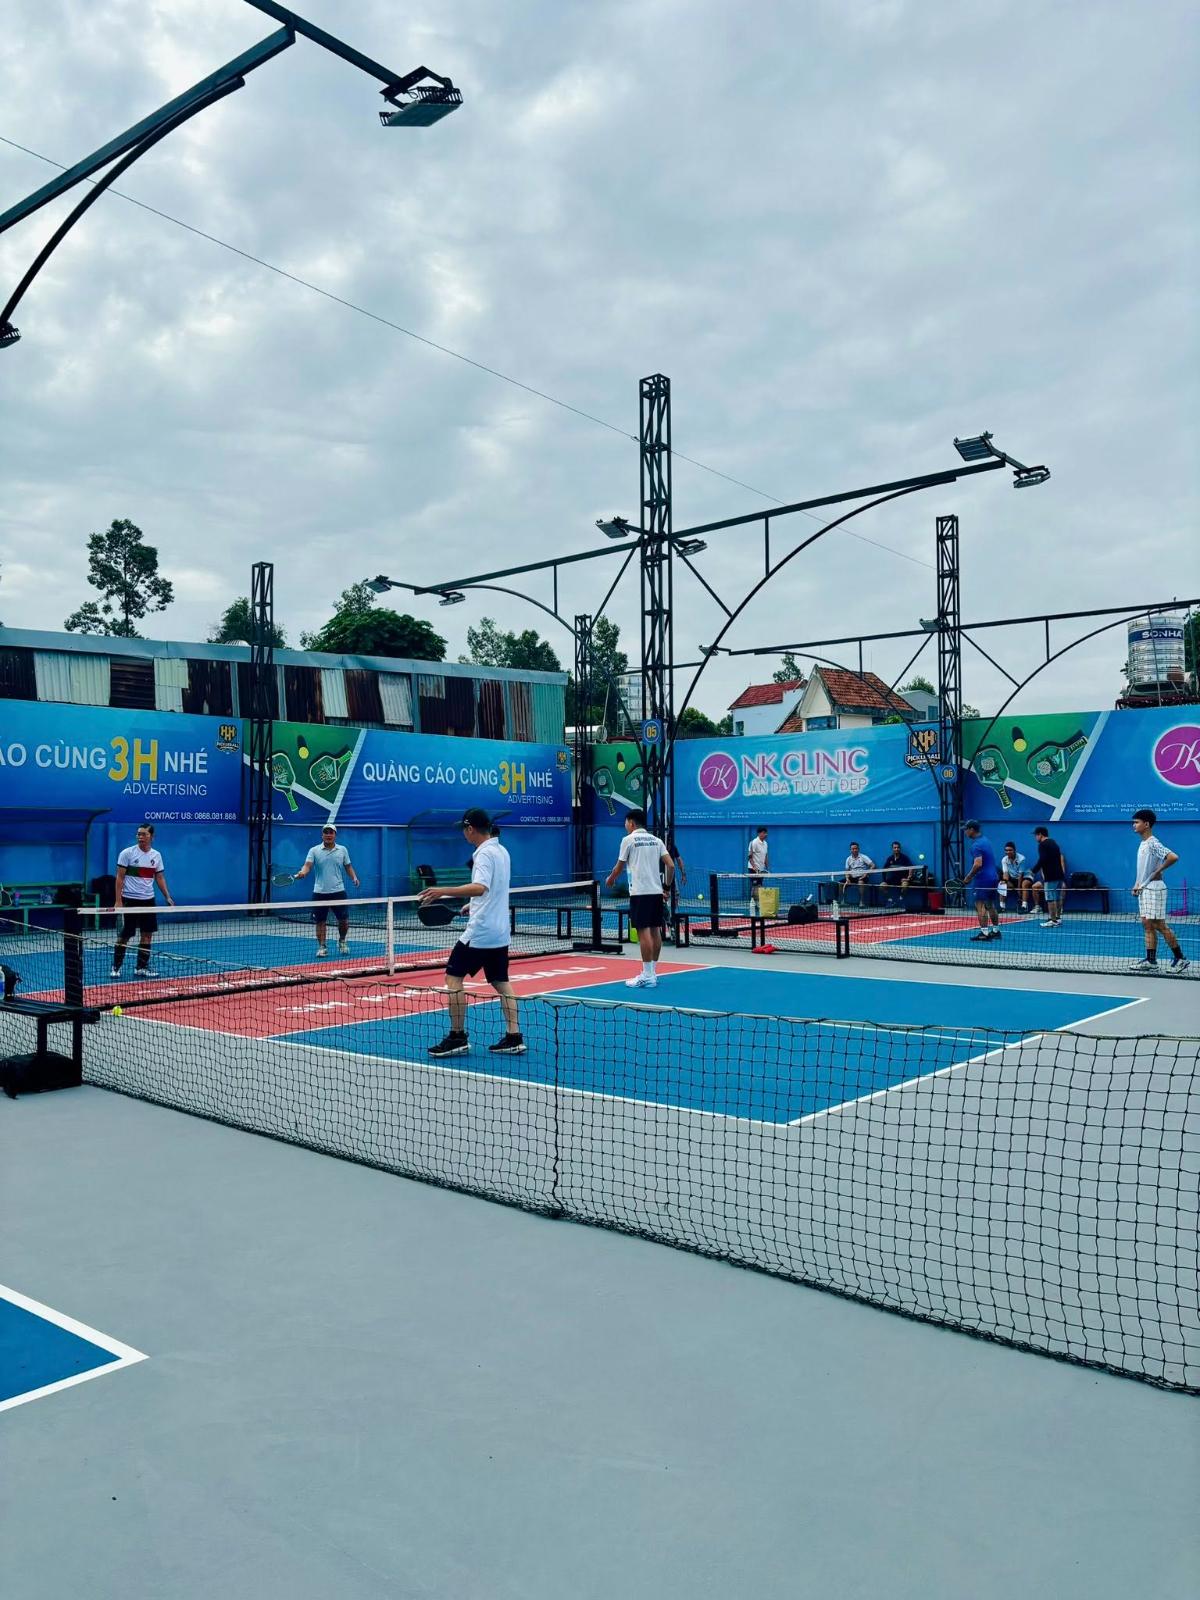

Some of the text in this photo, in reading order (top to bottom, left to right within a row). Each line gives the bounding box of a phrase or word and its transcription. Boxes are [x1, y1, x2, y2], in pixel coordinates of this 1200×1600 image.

[35, 738, 107, 770] CÙNG
[108, 735, 158, 781] 3H
[164, 747, 208, 774] NHÉ
[743, 748, 869, 779] NK CLINIC
[362, 759, 553, 794] QUẢNG CÁO CÙNG 3H NHÉ
[123, 782, 208, 796] ADVERTISING
[772, 779, 790, 795] DA
[508, 794, 554, 805] ADVERTISING
[144, 811, 179, 820] CONTACT
[180, 811, 193, 820] US:
